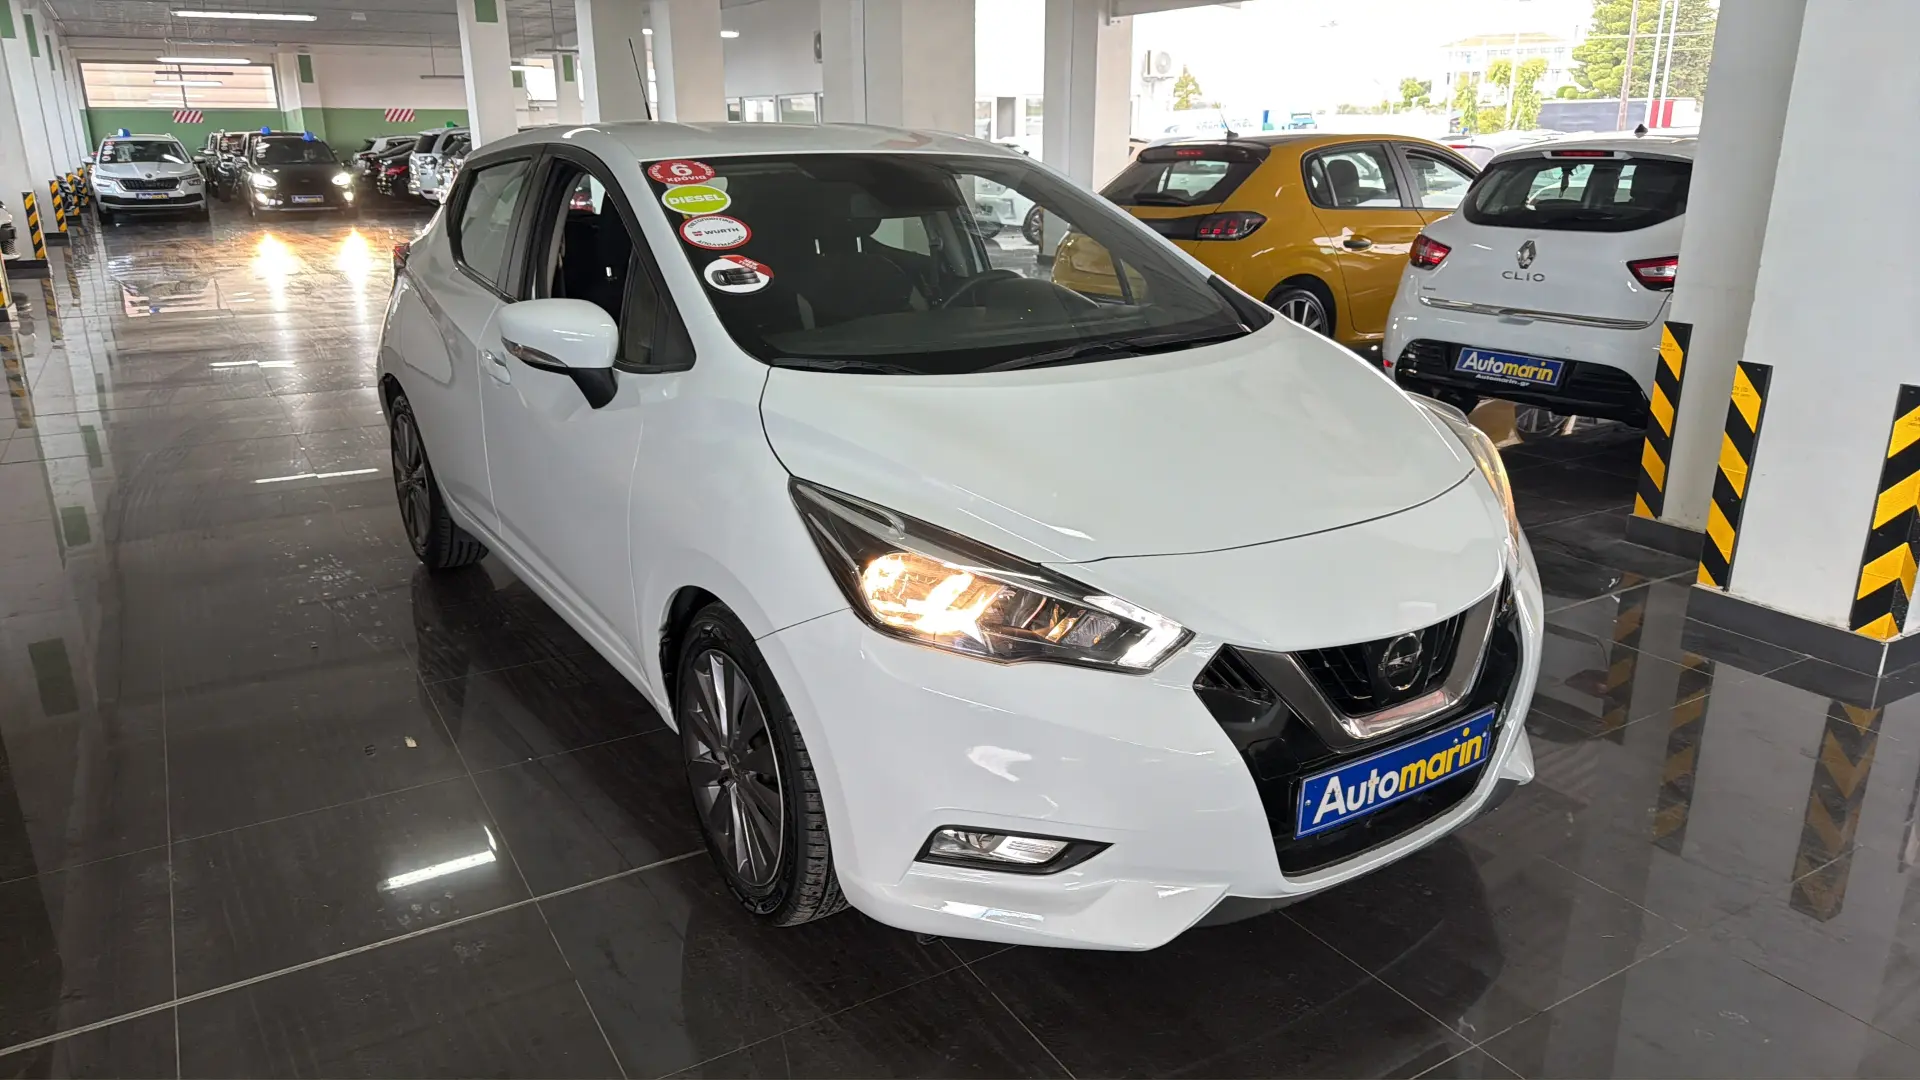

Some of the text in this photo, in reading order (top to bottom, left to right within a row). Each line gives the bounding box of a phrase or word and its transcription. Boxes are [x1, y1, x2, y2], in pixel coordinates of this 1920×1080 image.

[670, 164, 692, 177] 6
[666, 175, 707, 183] χρόνια
[668, 194, 725, 205] DIESEL
[1501, 270, 1546, 282] CLIO
[1462, 351, 1553, 382] Automarin
[1311, 727, 1483, 825] Automarin
